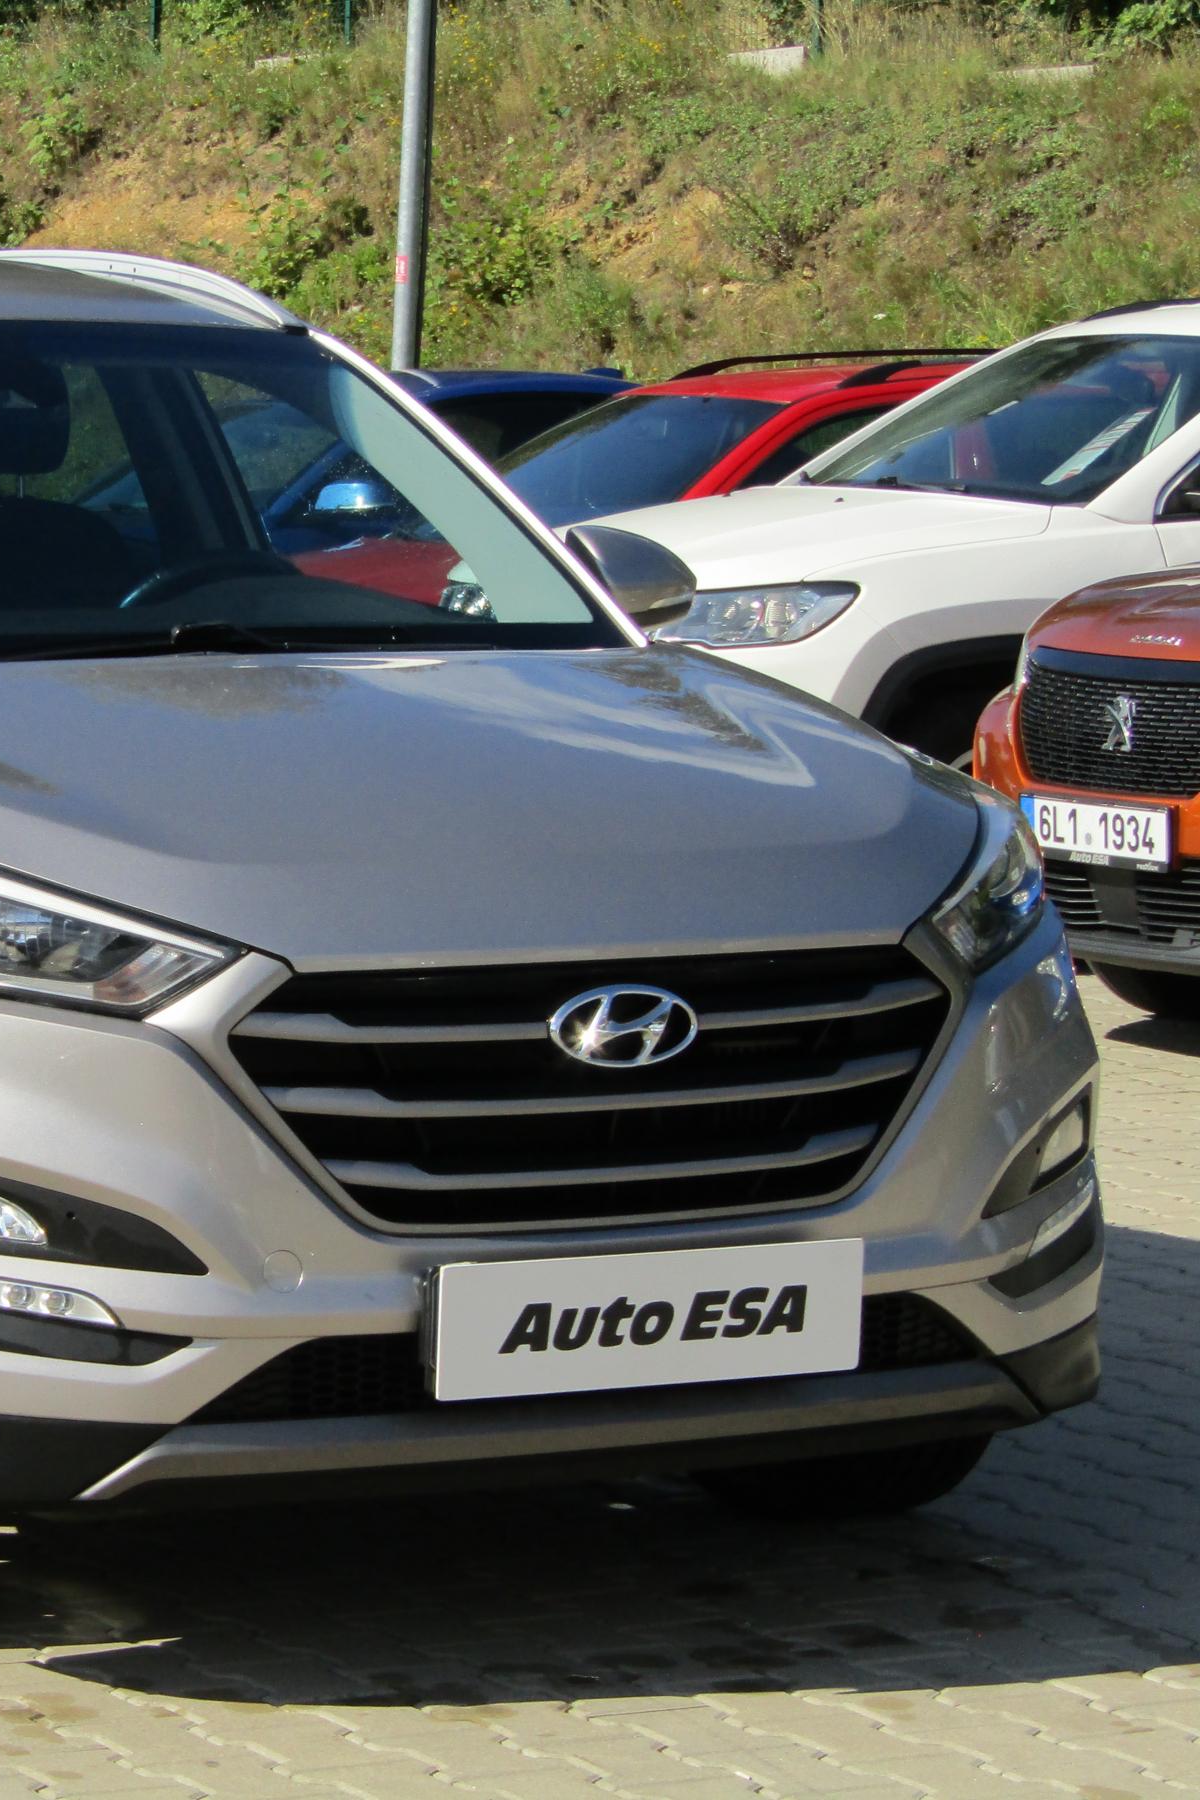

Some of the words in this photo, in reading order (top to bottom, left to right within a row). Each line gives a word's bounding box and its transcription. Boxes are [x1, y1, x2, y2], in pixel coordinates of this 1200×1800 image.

[1039, 805, 1078, 845] 6L1
[1099, 812, 1155, 854] 1934
[498, 1296, 674, 1354] Auto
[680, 1285, 808, 1341] ESA
